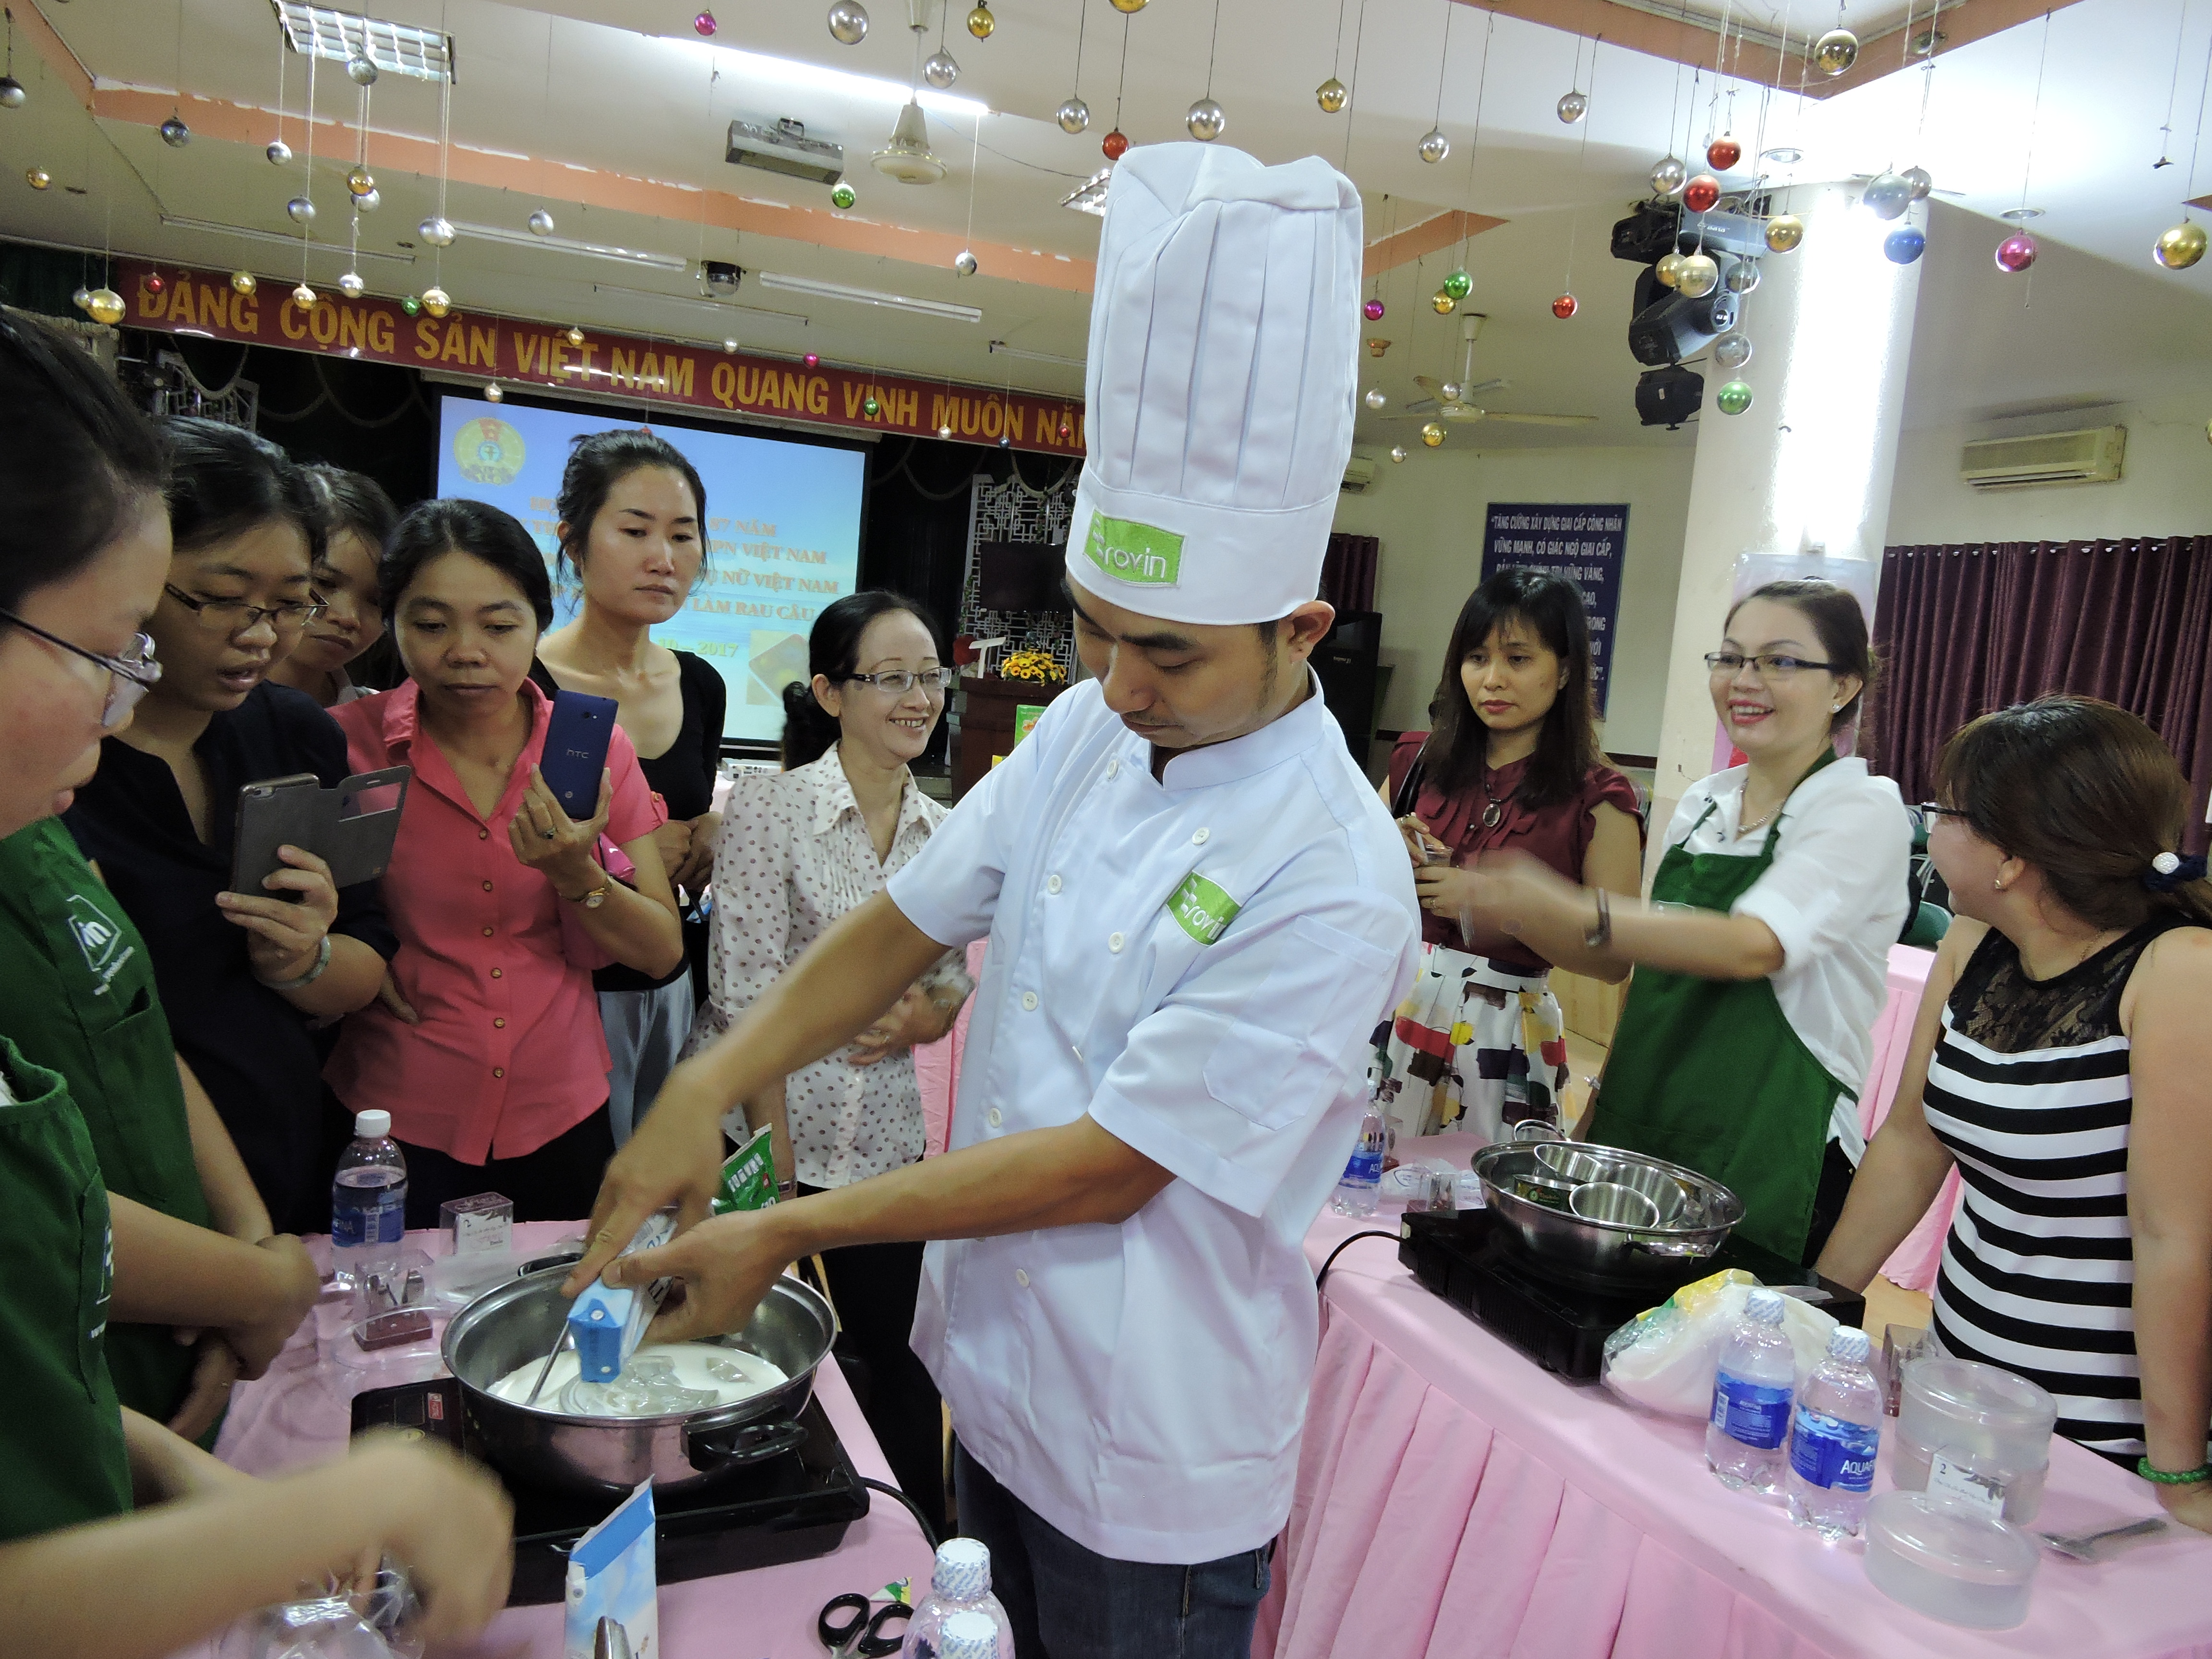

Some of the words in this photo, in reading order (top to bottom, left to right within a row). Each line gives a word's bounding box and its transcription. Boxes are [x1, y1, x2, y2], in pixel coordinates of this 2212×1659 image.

[137, 270, 259, 334] ĐẢNG
[280, 293, 395, 354] CỘNG
[415, 312, 498, 369] SẢN
[514, 329, 599, 384] VIỆT
[610, 347, 695, 397] NAM
[711, 361, 829, 416] QUANG
[843, 381, 919, 427] VINH
[931, 394, 1024, 440] MUÔN
[742, 541, 783, 562] VIỆT
[786, 547, 827, 564] NAM
[753, 572, 796, 592] VIỆT
[798, 578, 839, 594] NAM
[693, 594, 733, 613] LÀM
[735, 601, 773, 618] RAU
[697, 640, 739, 658] 2017
[1939, 1463, 1947, 1475] 2
